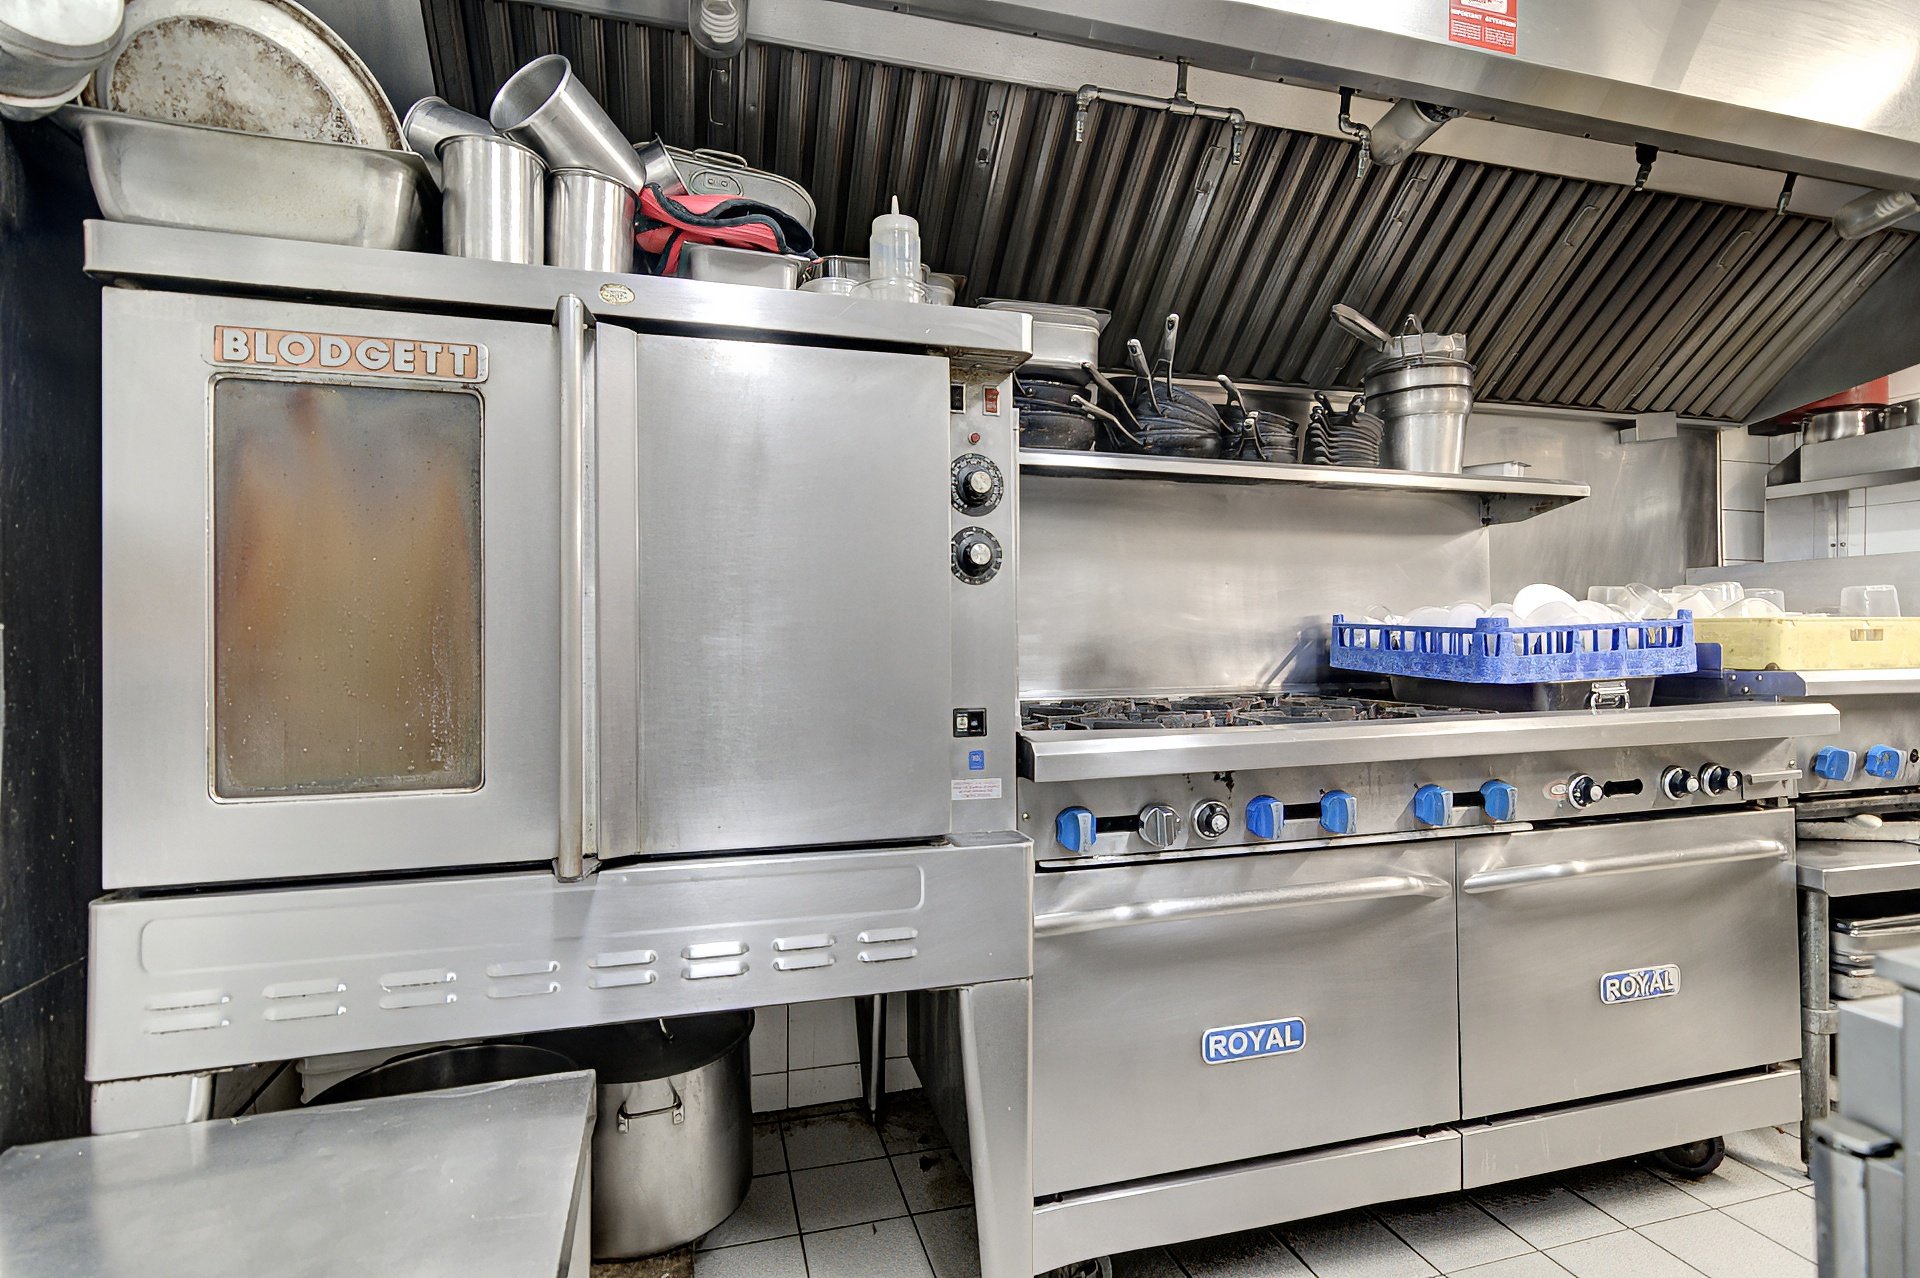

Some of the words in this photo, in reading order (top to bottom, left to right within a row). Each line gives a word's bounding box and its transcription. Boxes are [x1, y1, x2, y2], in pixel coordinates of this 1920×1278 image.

[222, 328, 472, 376] BLODGETT
[1606, 969, 1675, 1001] ROYAL
[1208, 1025, 1301, 1058] ROYAL
